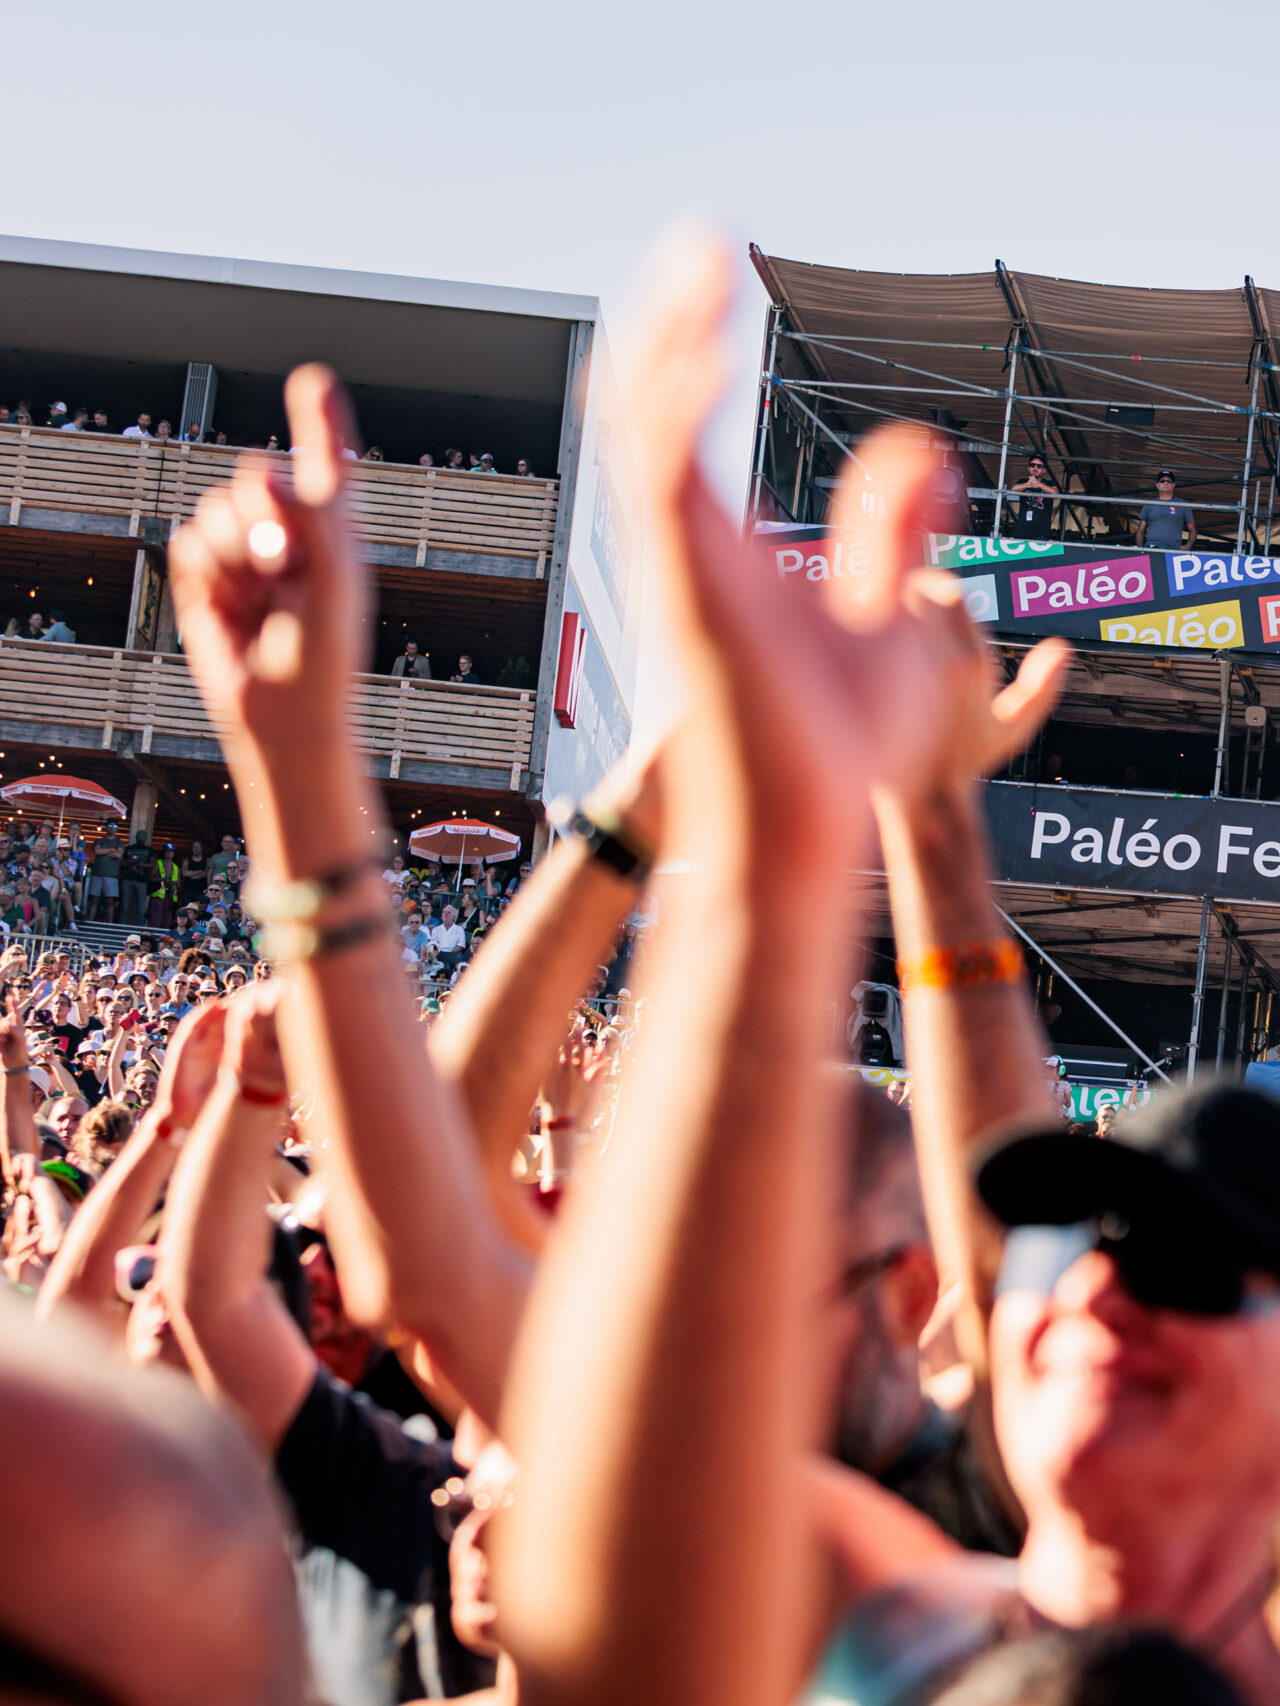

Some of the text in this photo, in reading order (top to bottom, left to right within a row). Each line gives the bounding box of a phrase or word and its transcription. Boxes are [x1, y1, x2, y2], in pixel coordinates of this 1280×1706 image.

[775, 540, 872, 582] Palé
[1018, 566, 1147, 612] Paléo
[1030, 811, 1202, 871] Paléo
